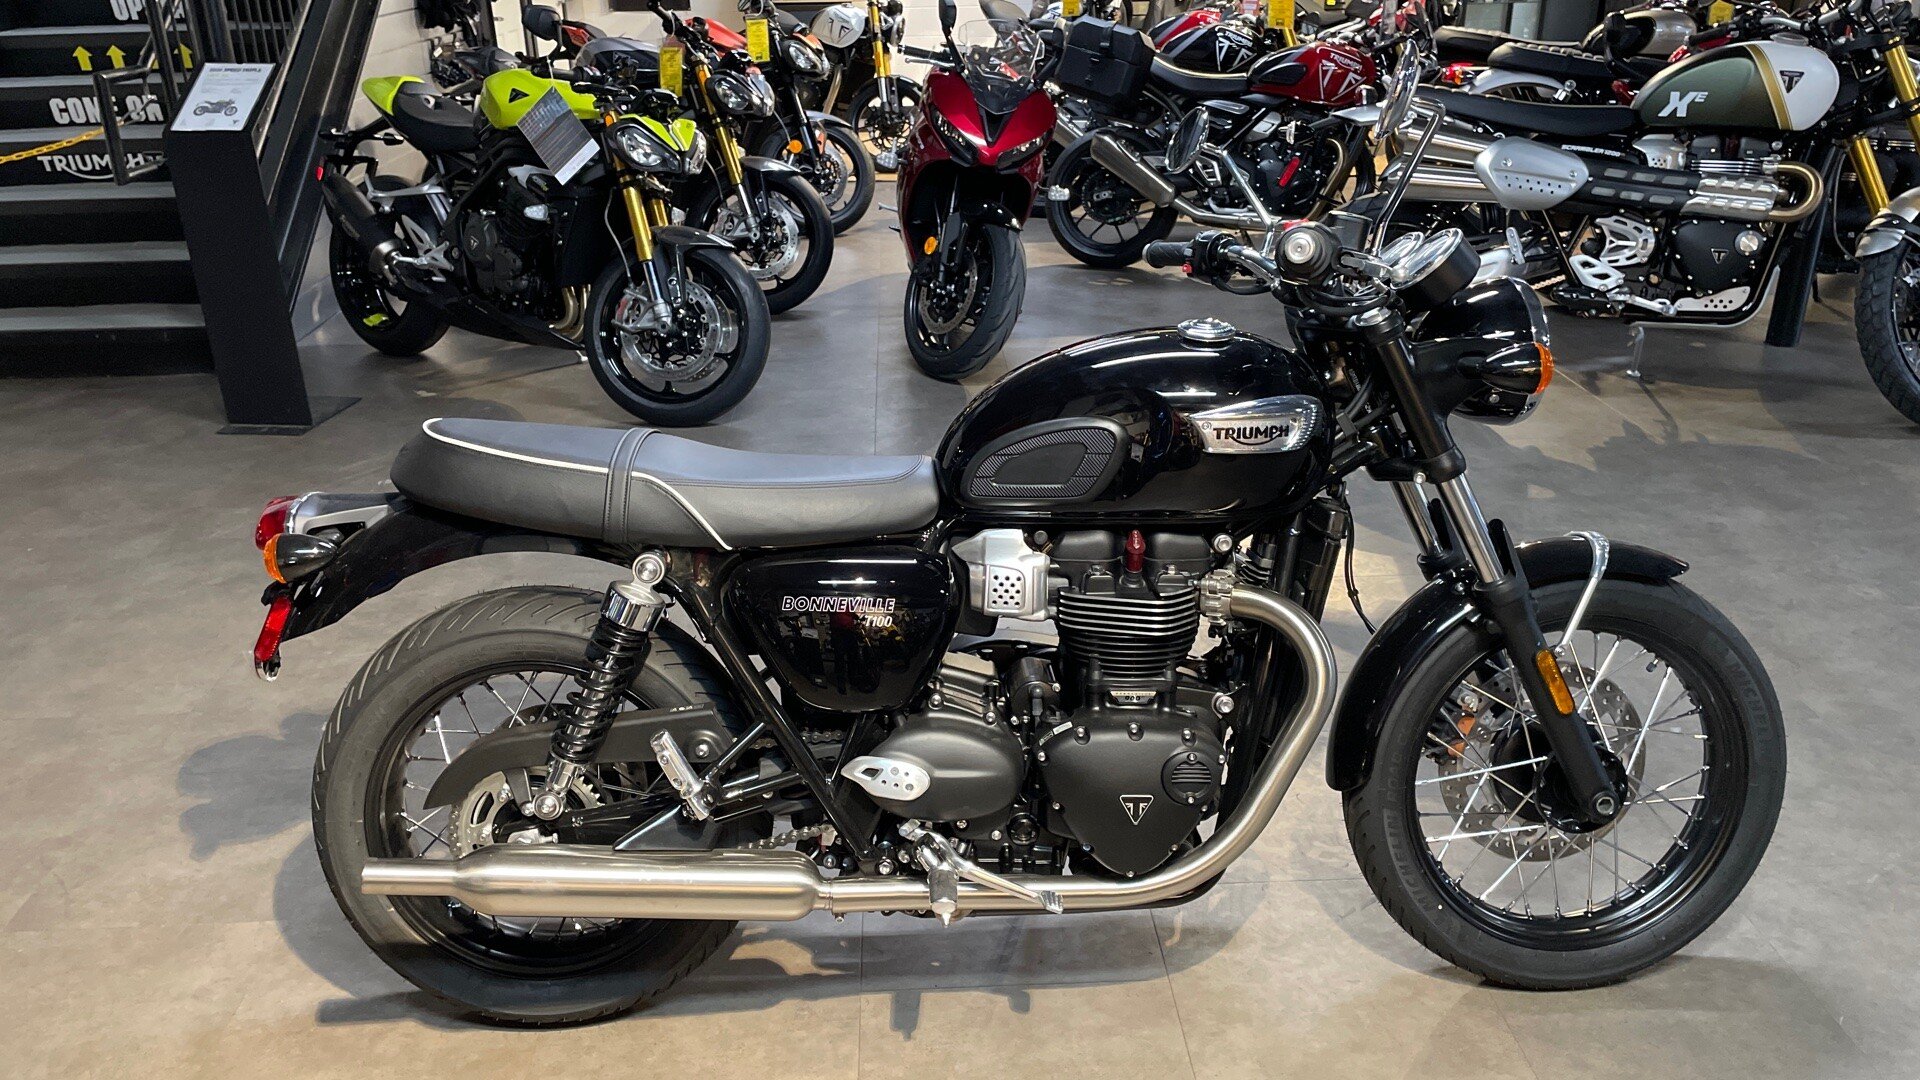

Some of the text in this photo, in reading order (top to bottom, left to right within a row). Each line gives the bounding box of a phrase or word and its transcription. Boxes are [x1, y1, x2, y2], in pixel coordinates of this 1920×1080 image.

[125, 94, 164, 121] ON
[1657, 91, 1709, 117] XE
[36, 152, 146, 178] TRIUMH
[1213, 425, 1290, 445] TRIUMPH
[782, 596, 896, 613] BONNEVILLE
[865, 615, 893, 627] T100
[1384, 808, 1434, 913] MICHELIN
